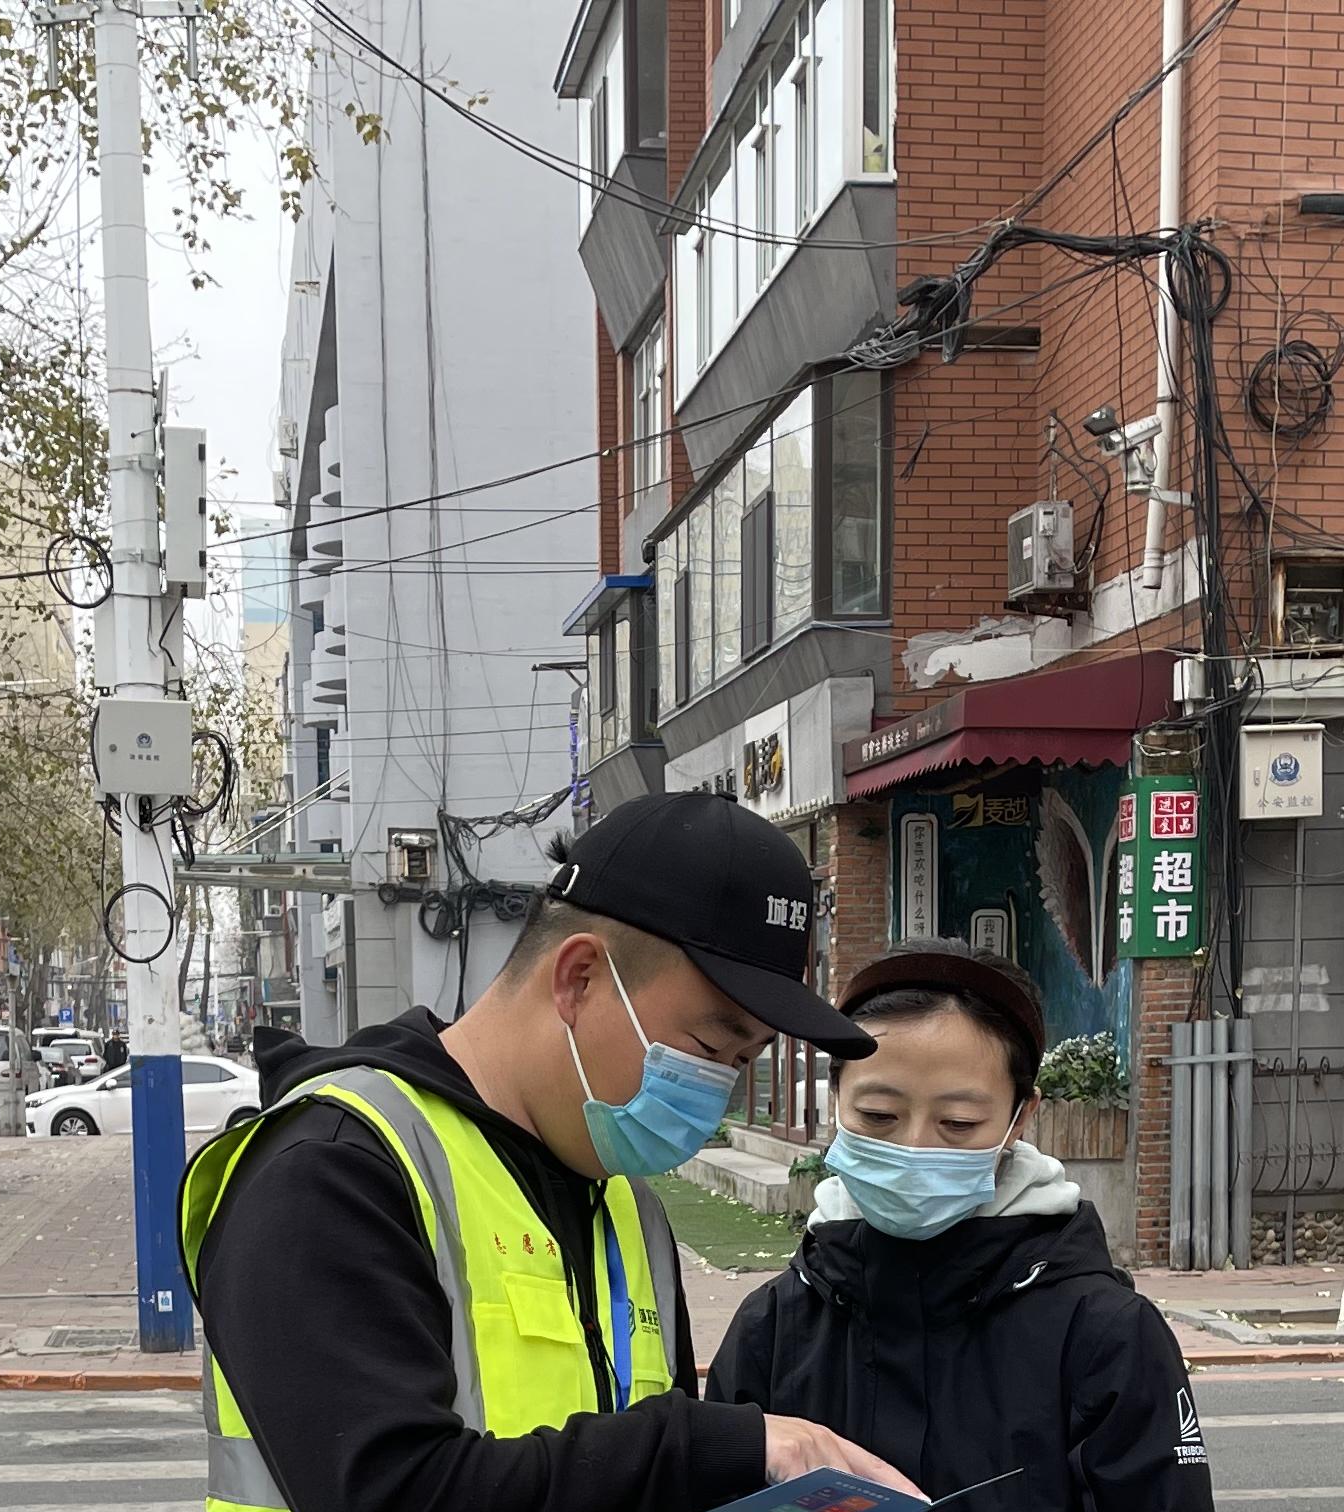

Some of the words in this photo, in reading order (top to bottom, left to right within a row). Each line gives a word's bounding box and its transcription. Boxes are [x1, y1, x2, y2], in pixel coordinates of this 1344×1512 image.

[1256, 795, 1314, 808] 公安监控
[765, 894, 808, 932] 城投
[1119, 854, 1134, 943] 超市
[1152, 850, 1194, 942] 超市
